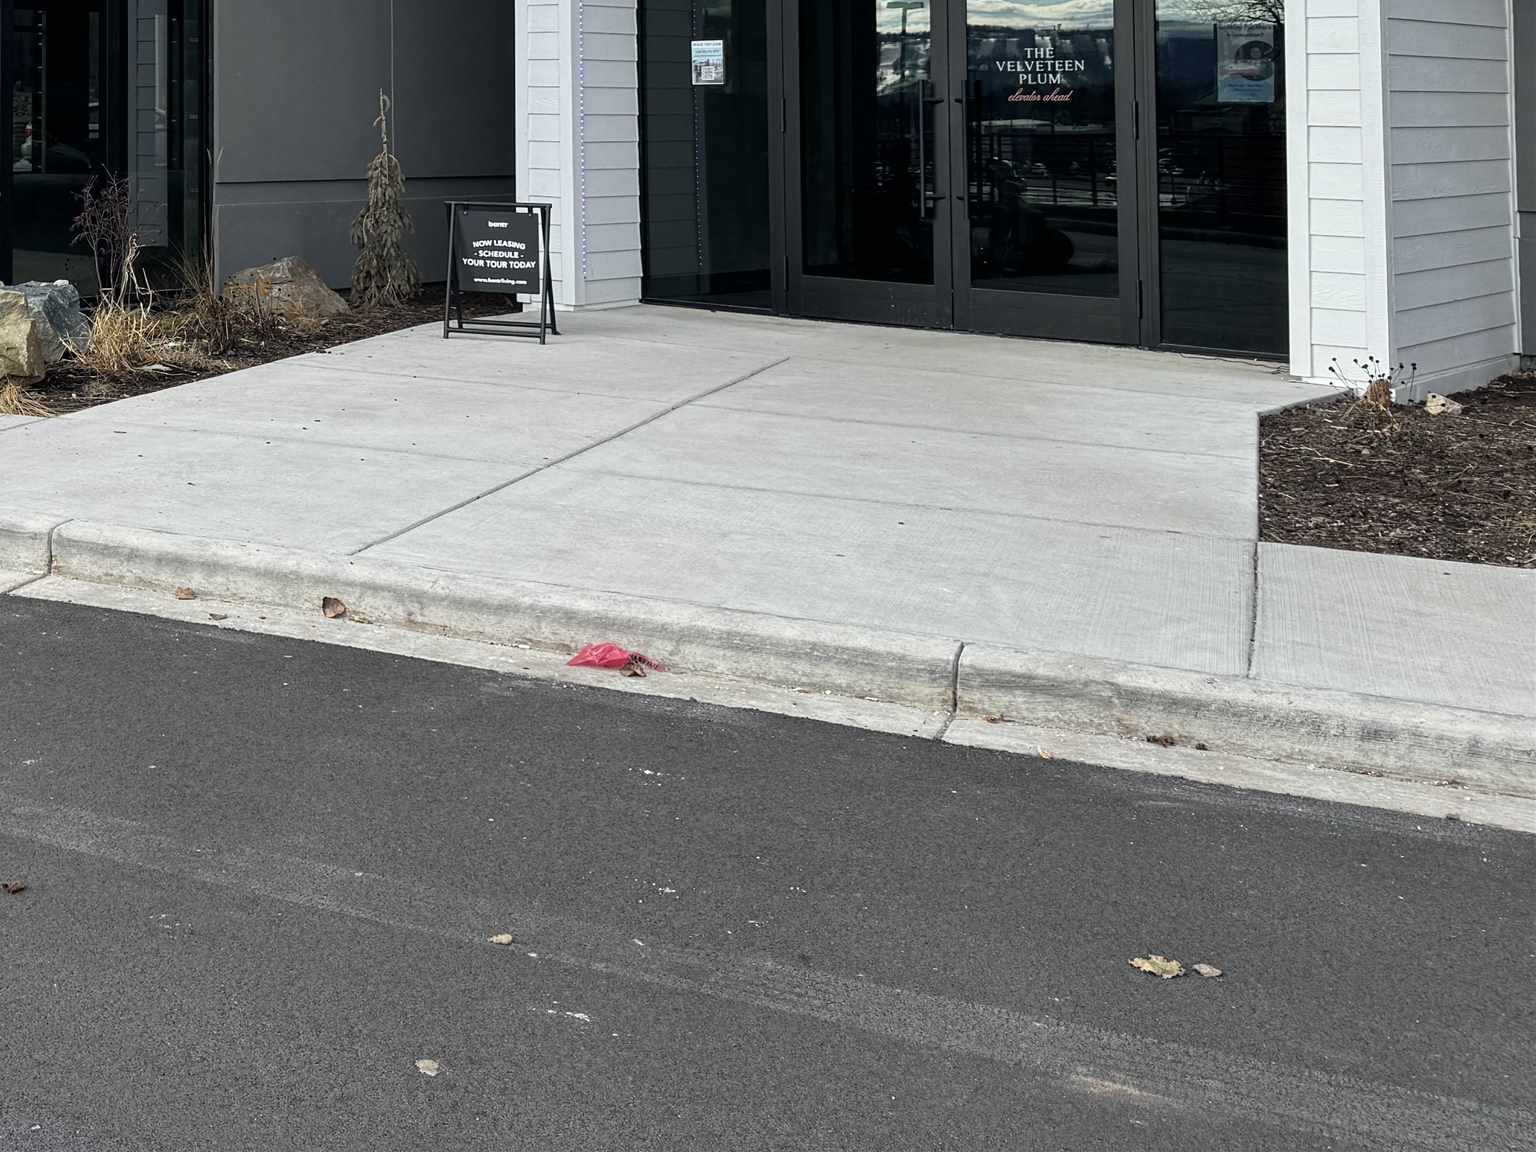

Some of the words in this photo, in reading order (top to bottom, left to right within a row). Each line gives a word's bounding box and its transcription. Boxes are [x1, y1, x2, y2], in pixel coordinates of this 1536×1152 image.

[1024, 47, 1055, 59] THE
[995, 59, 1085, 72] VELVETEEN
[1019, 73, 1061, 85] PLUM
[1007, 88, 1041, 102] elevator
[472, 240, 492, 248] NOW
[494, 240, 526, 250] LEASING
[478, 250, 519, 259] SCHEDULE
[462, 258, 485, 267] YOUR
[485, 260, 508, 268] TOUR
[509, 261, 536, 269] TODAY
